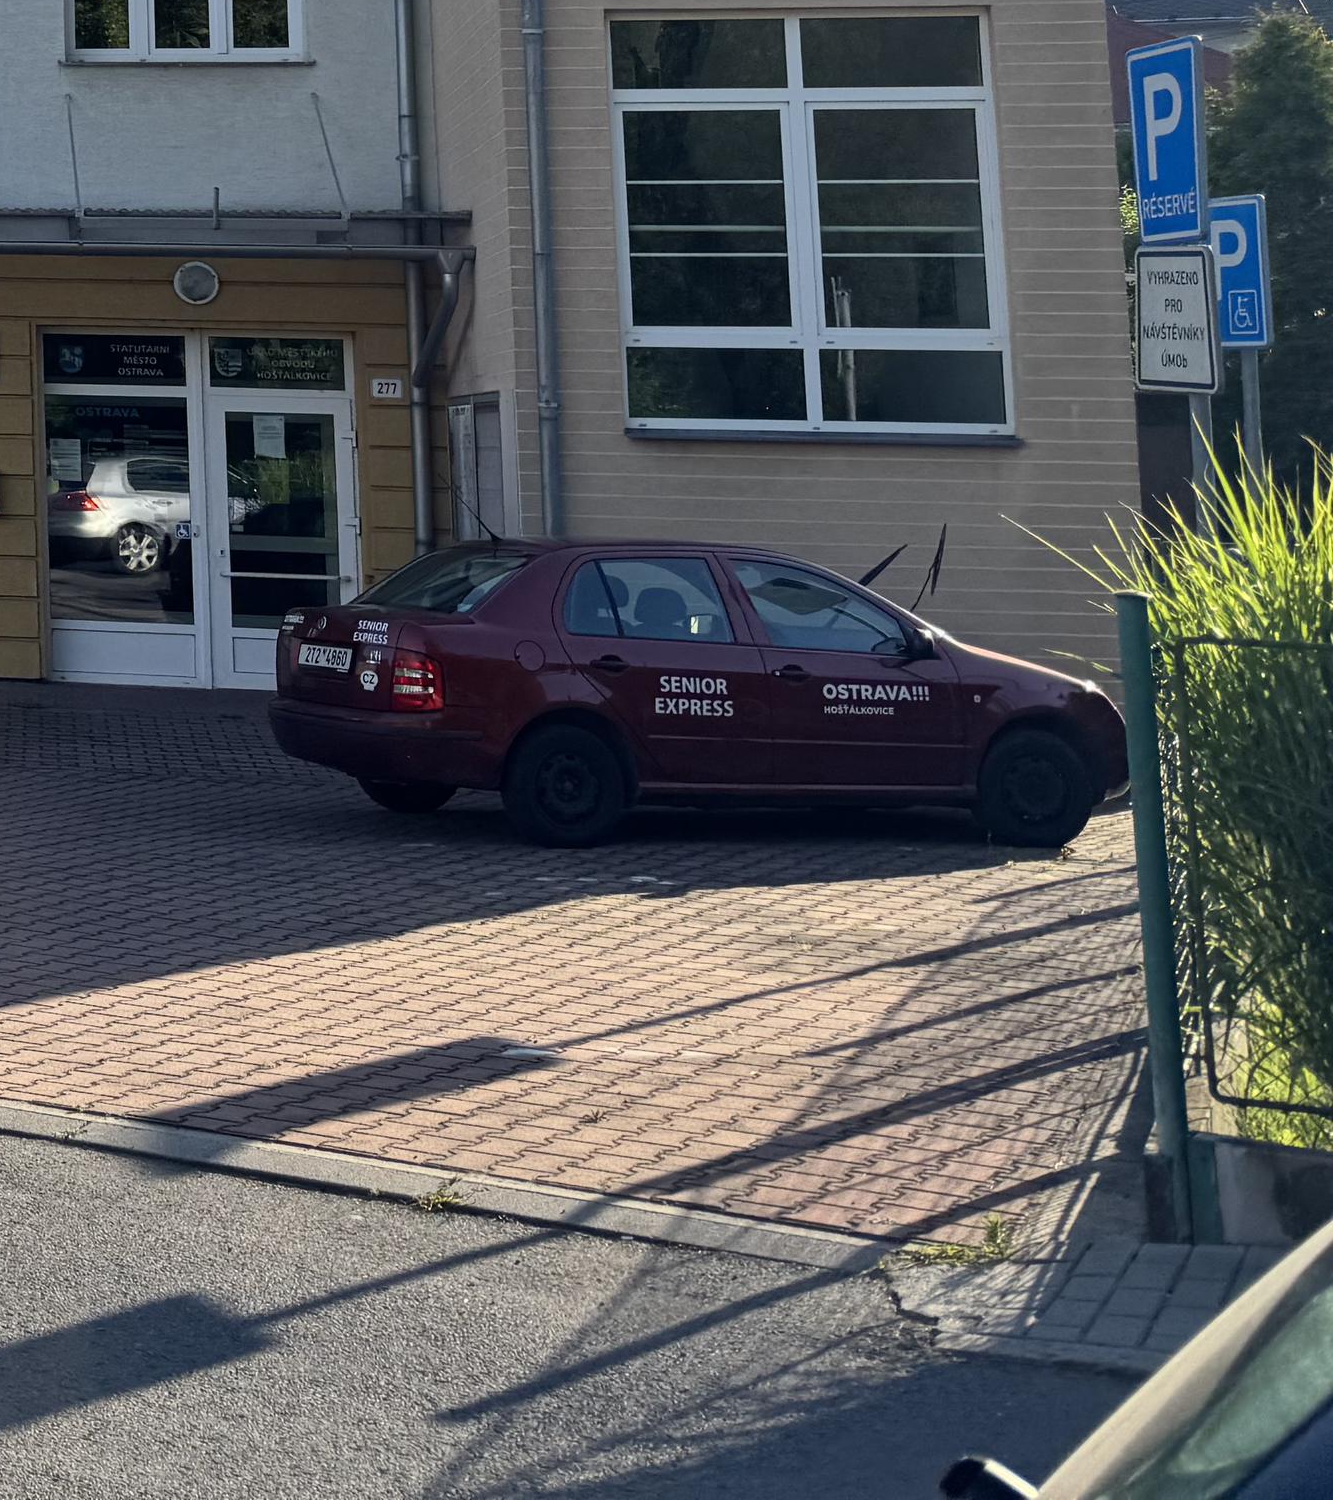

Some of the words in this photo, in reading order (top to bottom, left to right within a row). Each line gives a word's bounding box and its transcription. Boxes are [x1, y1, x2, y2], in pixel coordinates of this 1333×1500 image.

[1143, 72, 1182, 182] P
[1143, 187, 1196, 220] RÉSERVÉ
[1210, 219, 1247, 301] P
[1146, 270, 1199, 286] VYHRAZENO
[1164, 298, 1183, 313] PRO
[1142, 322, 1205, 341] NÁVŠTĚVNÍKY
[118, 367, 164, 377] OSTRAVA
[377, 382, 397, 394] 277
[75, 406, 140, 417] OSTRAVA
[358, 620, 389, 632] SENIOR
[353, 631, 389, 645] EXPRESS
[305, 646, 321, 664] 2T2
[363, 672, 376, 685] CZ
[659, 675, 728, 695] SENIOR
[822, 683, 930, 701] OSTRAVA!!!
[654, 697, 734, 717] EXPRESS
[824, 704, 895, 715] HOŠŤÁLKOVICE
